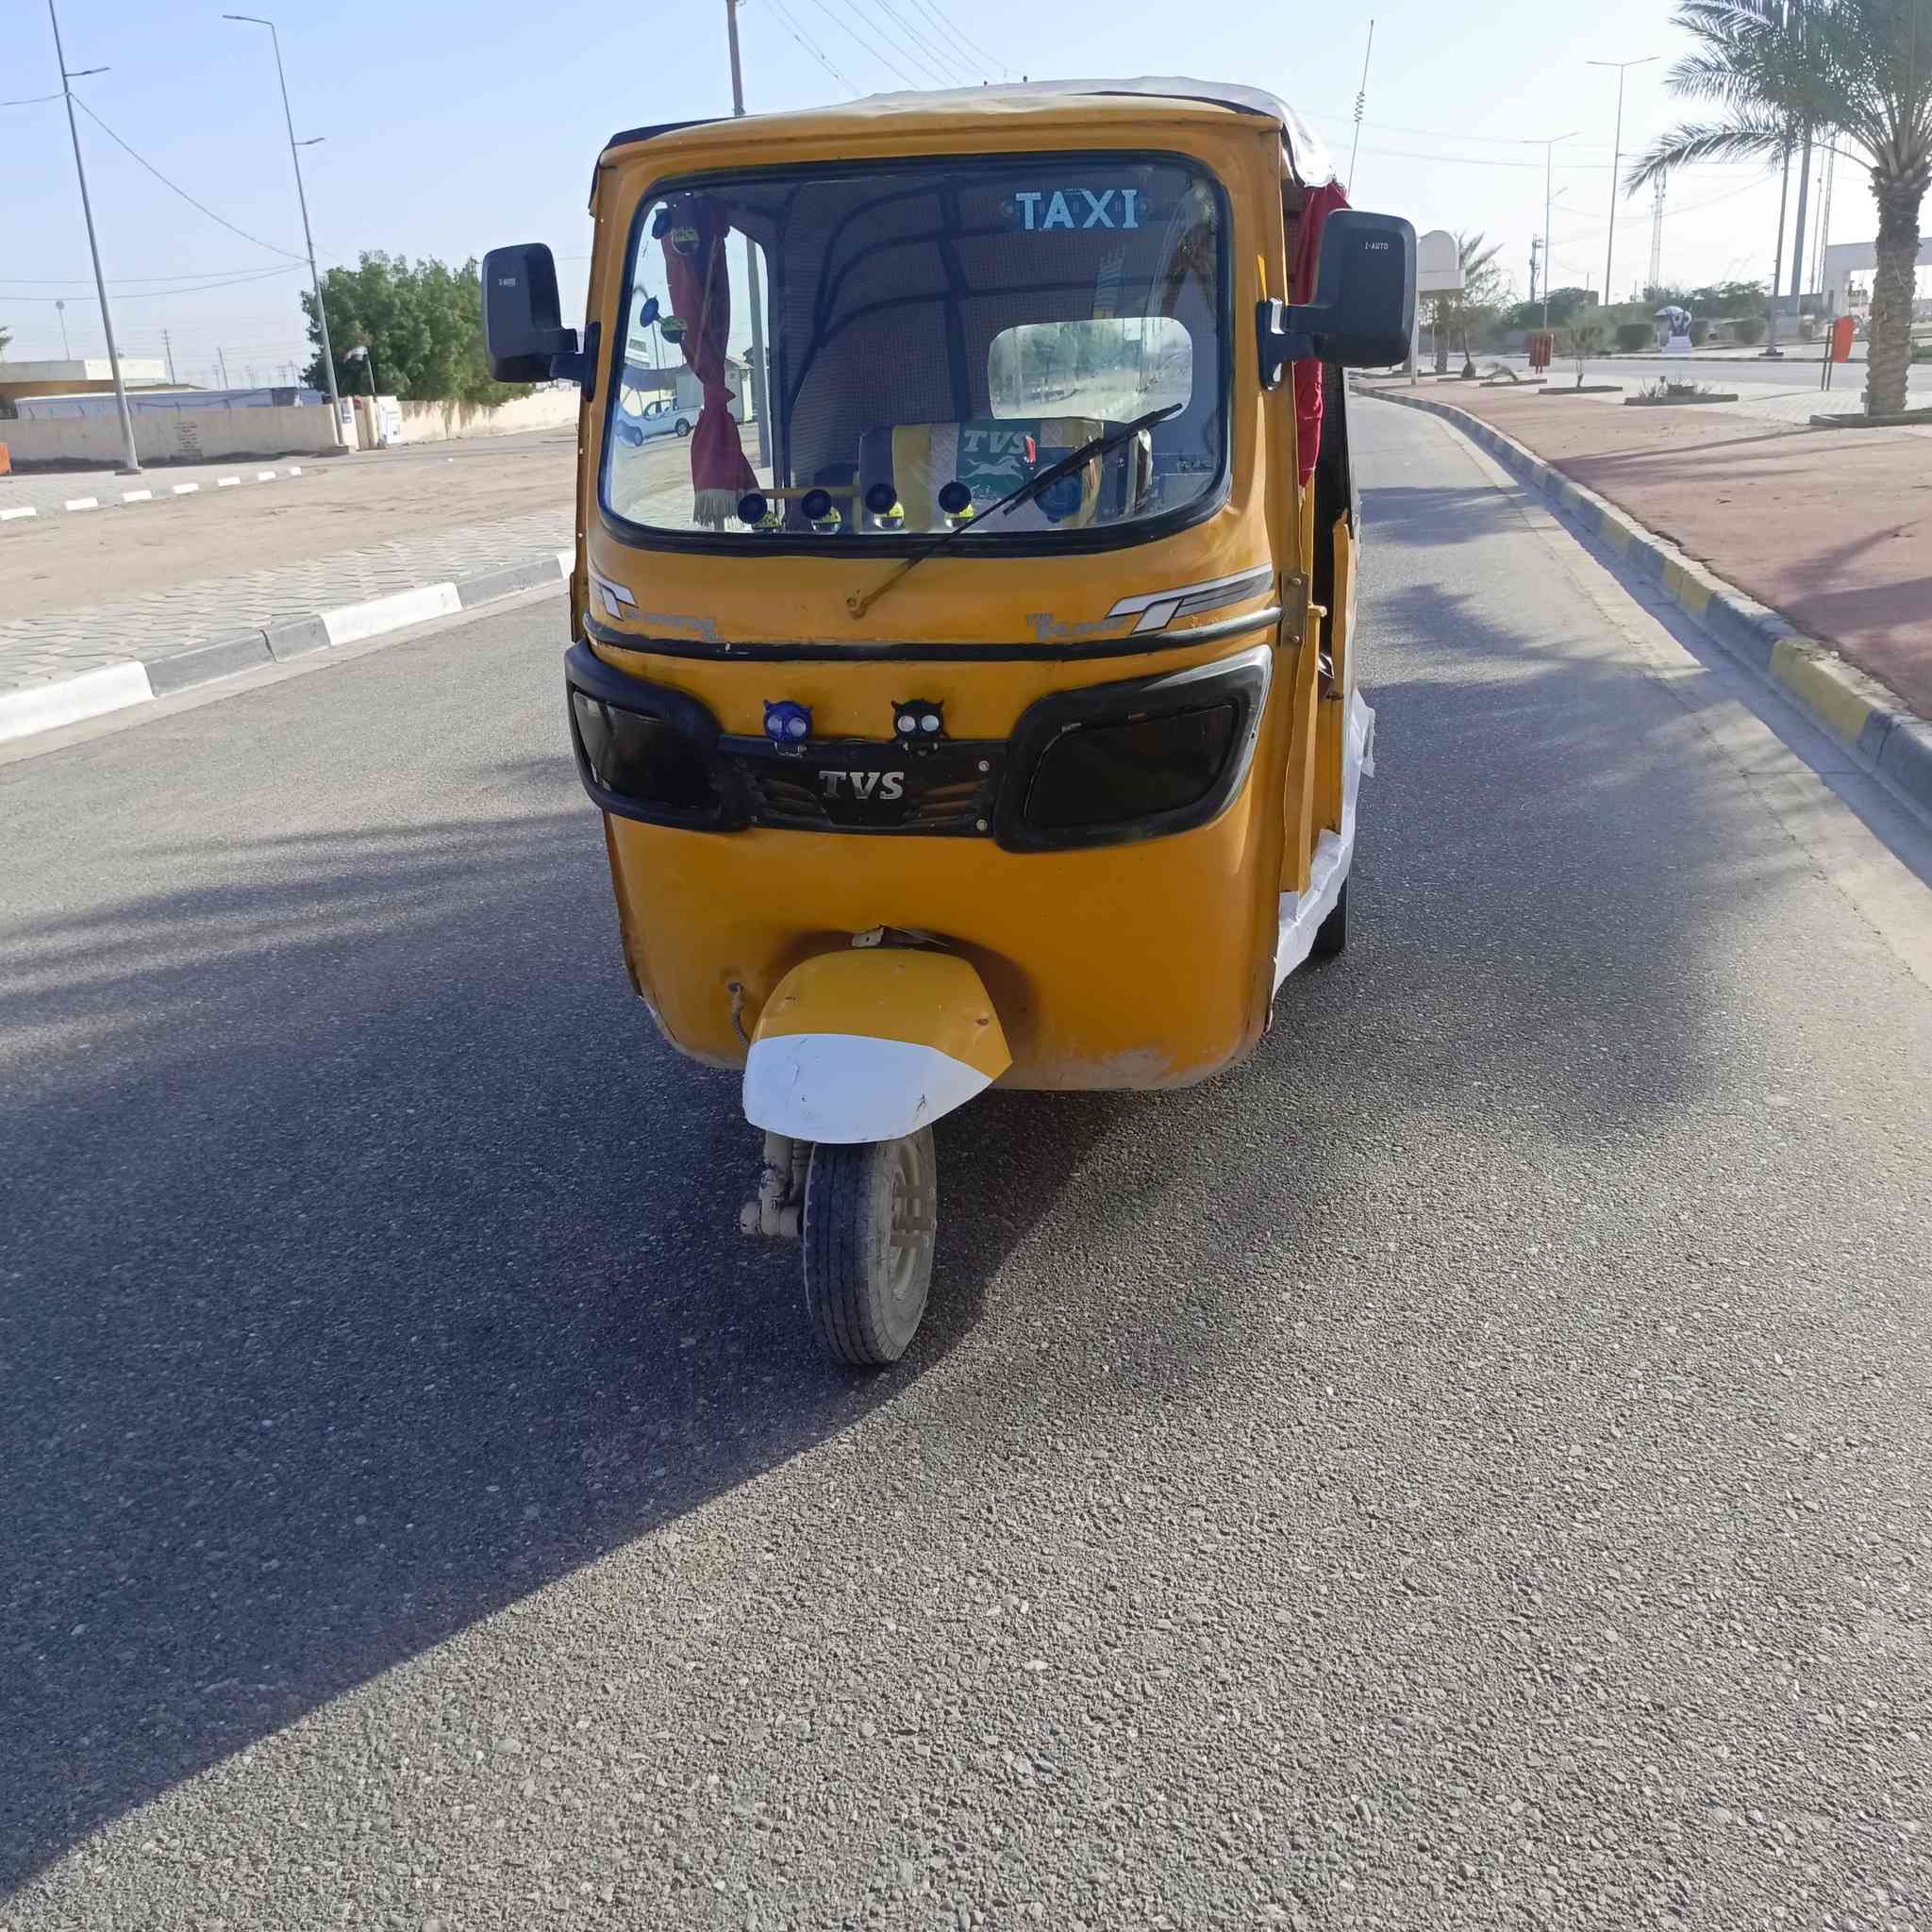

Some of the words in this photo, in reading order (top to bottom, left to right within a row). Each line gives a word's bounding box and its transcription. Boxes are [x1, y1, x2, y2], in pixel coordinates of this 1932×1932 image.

[1015, 189, 1140, 230] TAXI
[964, 429, 1031, 455] TVS
[819, 771, 905, 800] TVS
